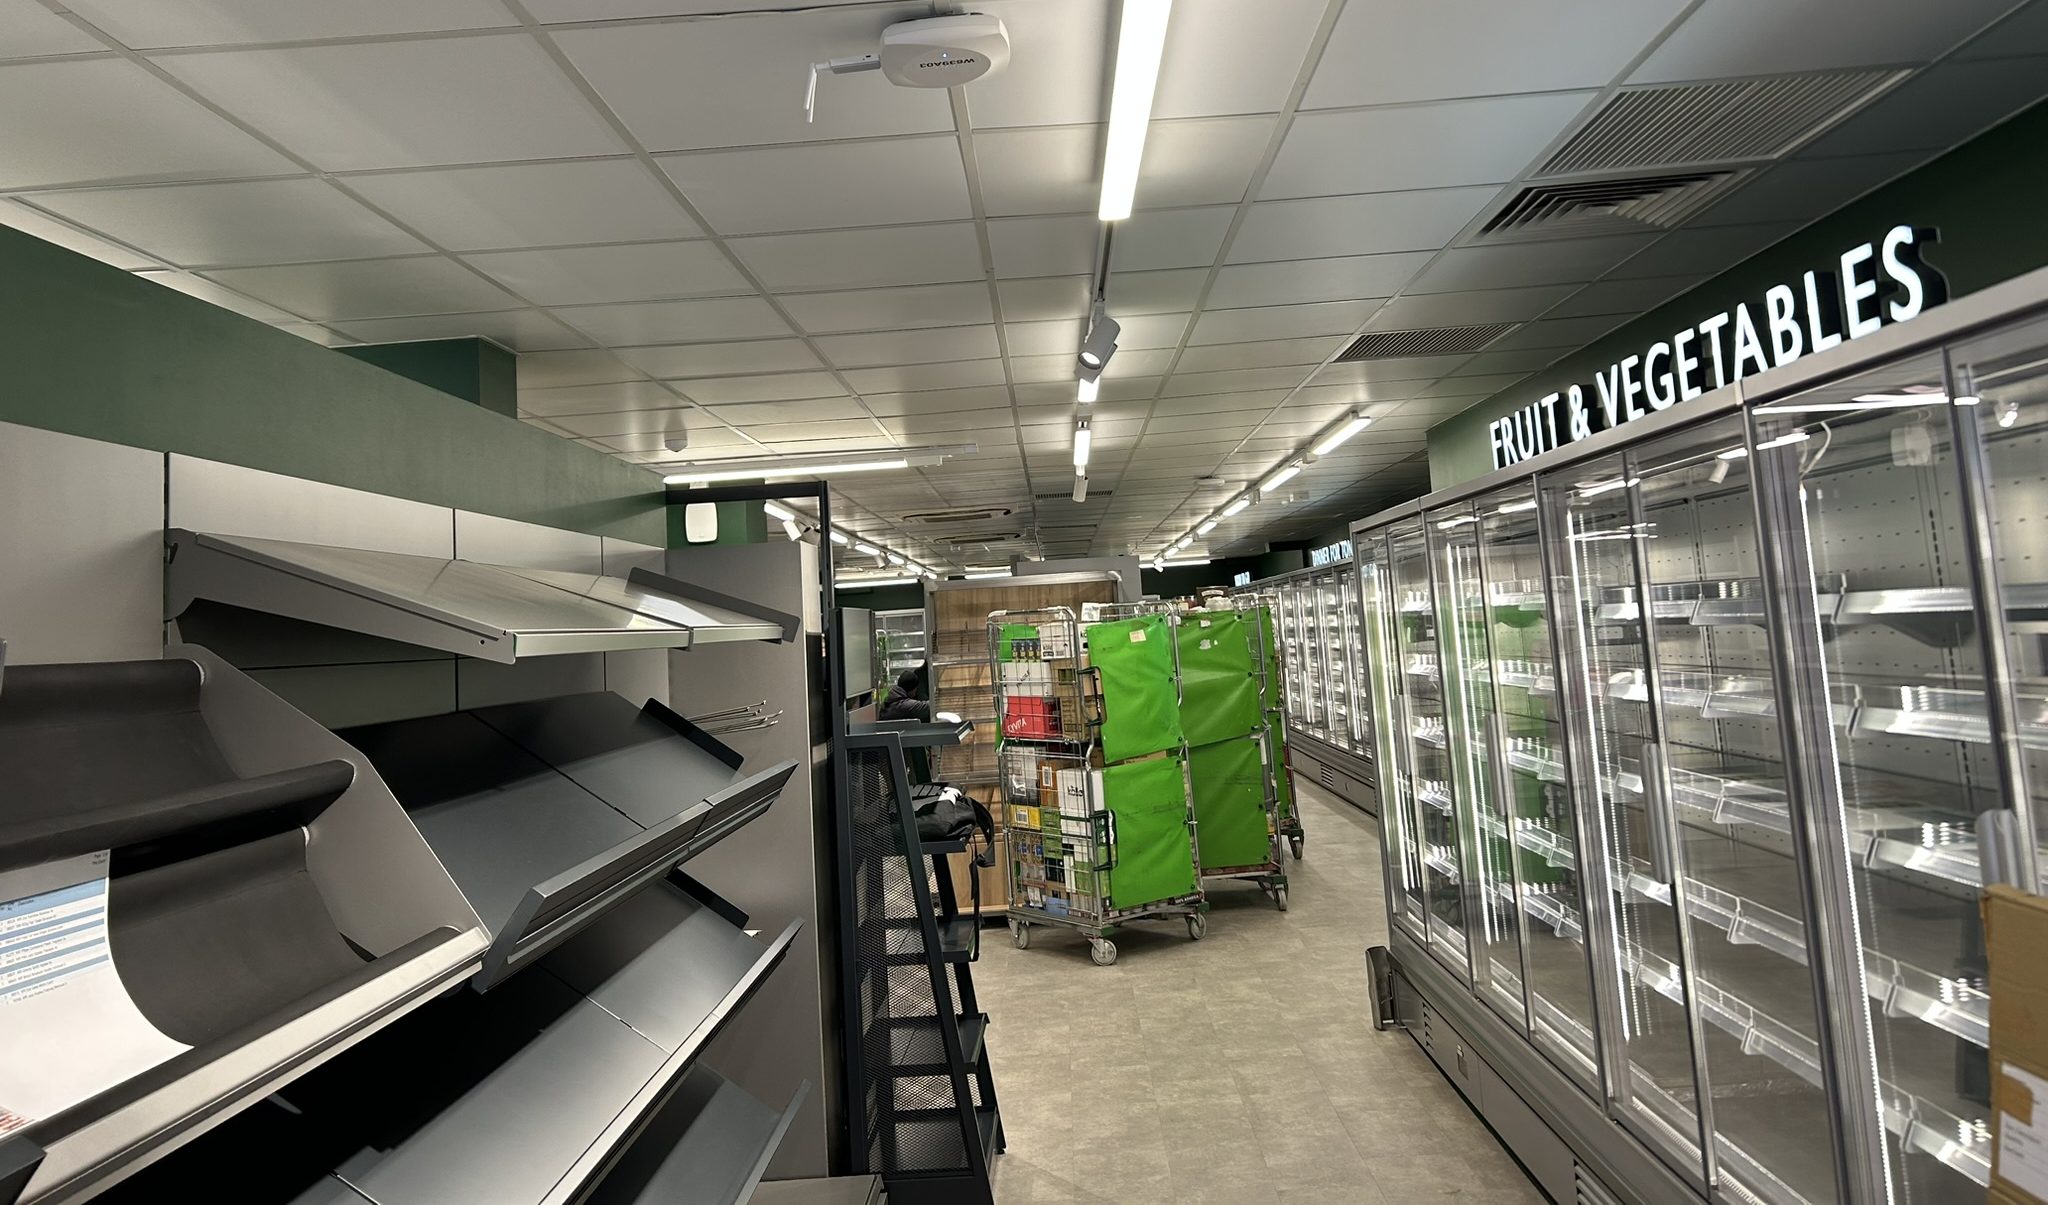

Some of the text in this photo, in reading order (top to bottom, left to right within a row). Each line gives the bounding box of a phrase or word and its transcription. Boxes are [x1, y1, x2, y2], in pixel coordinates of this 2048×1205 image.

[1489, 225, 1924, 471] FRUIT & VEGETABLES
